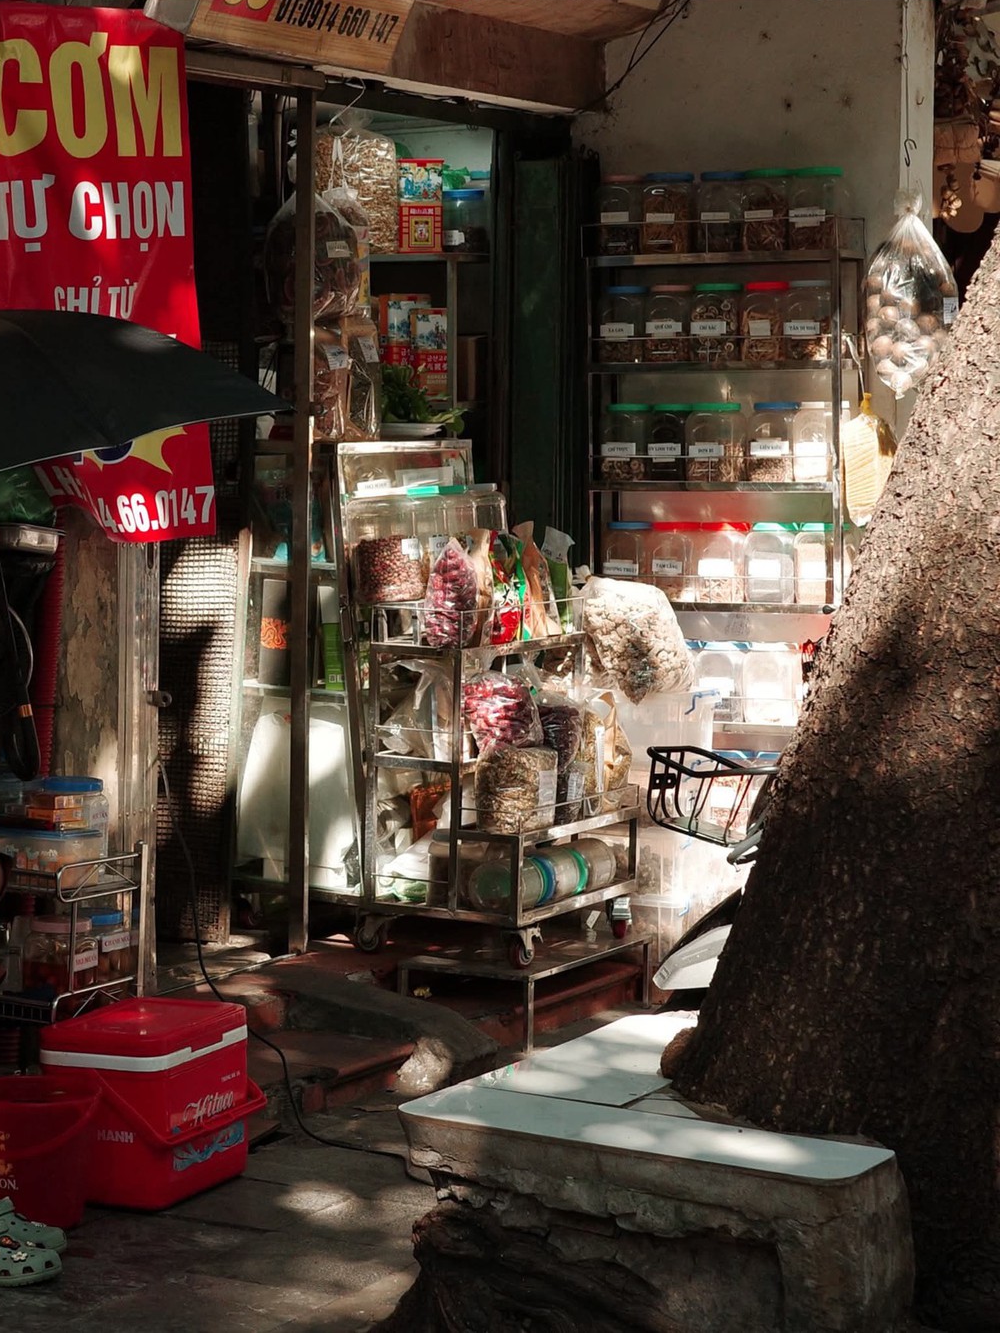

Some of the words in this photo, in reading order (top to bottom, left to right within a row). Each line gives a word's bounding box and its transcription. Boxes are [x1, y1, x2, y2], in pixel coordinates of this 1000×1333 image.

[337, 6, 370, 39] 660
[368, 12, 399, 45] 147
[68, 180, 186, 253] CHỌN
[54, 275, 103, 315] CHỈ
[107, 278, 138, 320] TỪ
